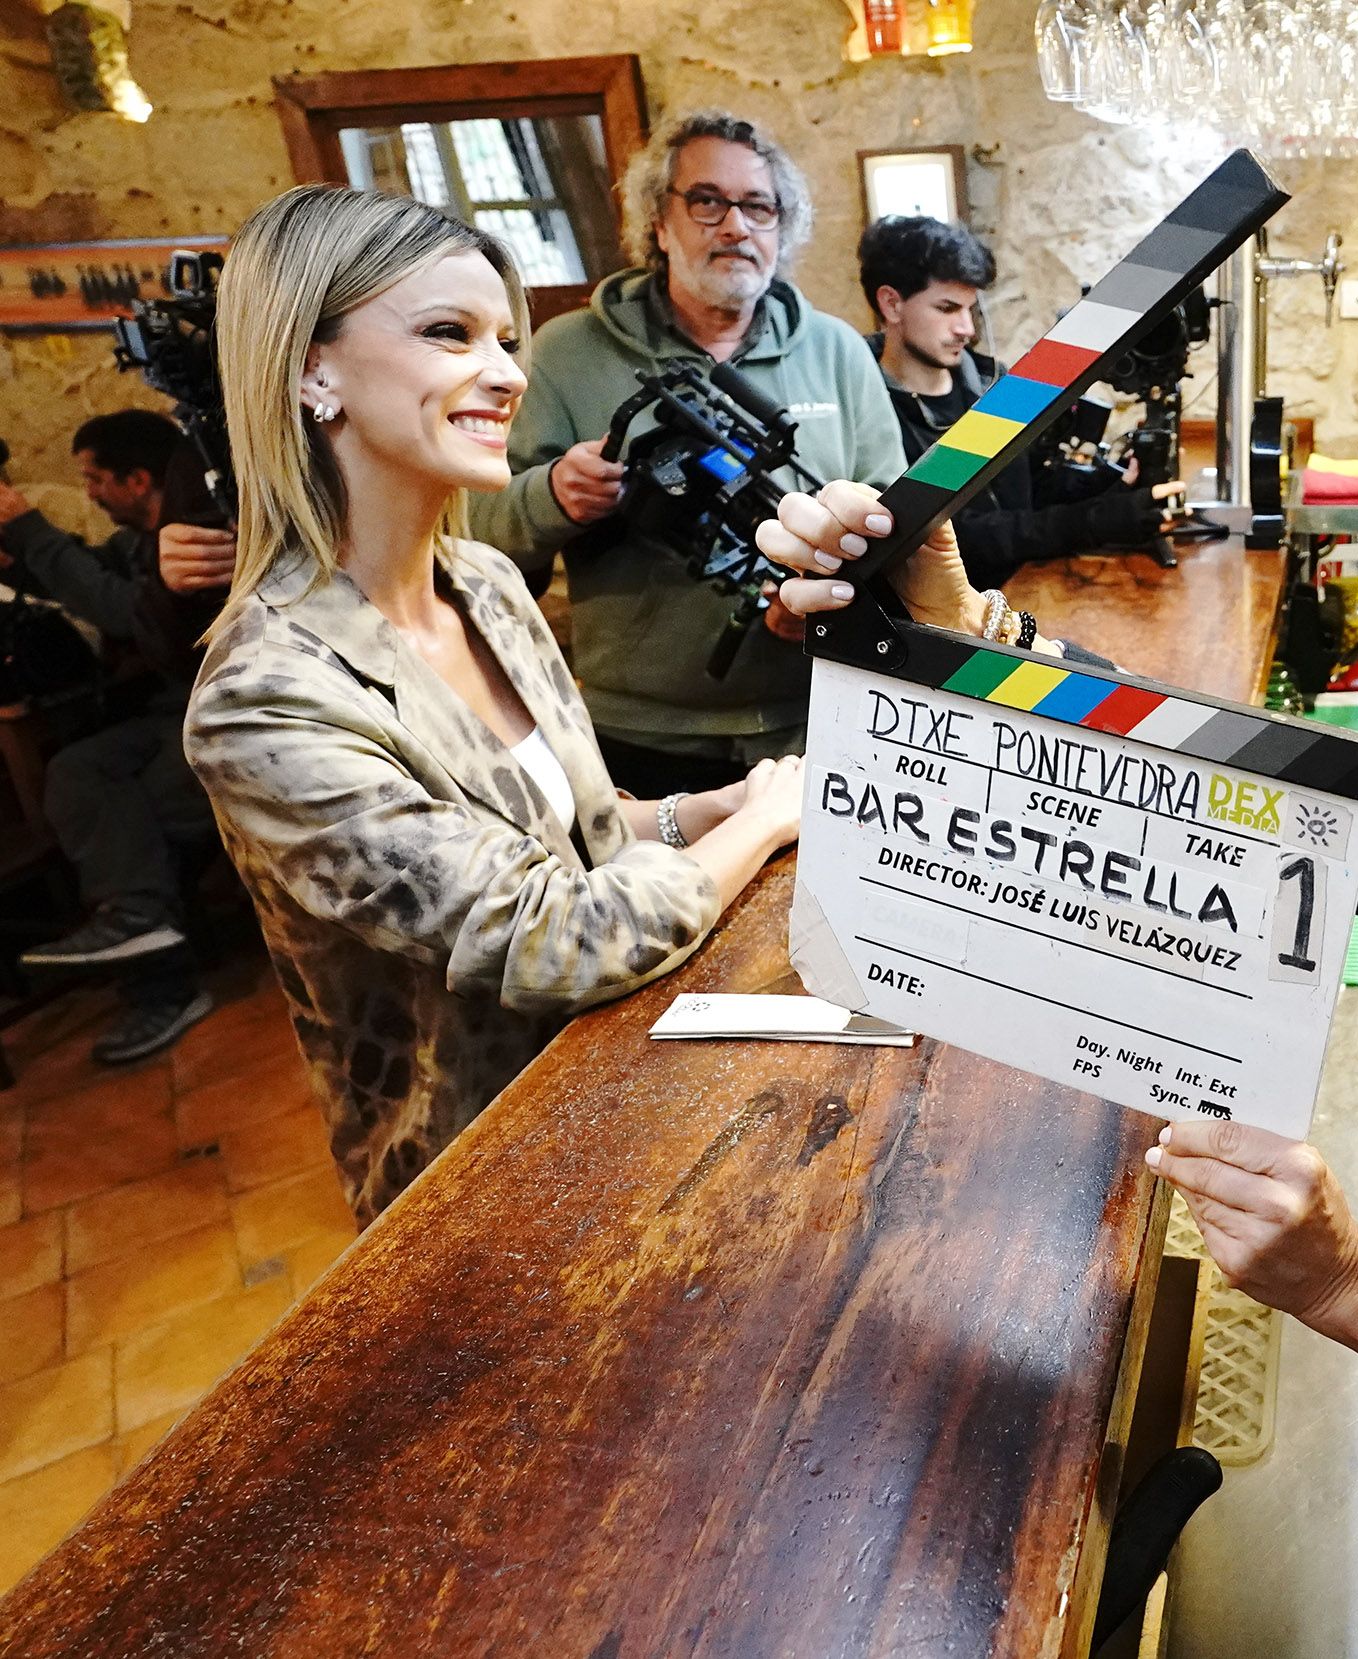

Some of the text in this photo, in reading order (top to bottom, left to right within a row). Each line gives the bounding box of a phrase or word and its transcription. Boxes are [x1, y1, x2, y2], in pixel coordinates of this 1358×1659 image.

[895, 754, 948, 786] ROLL
[992, 721, 1200, 819] PONTEVEDRA
[1026, 790, 1103, 828] SCENE
[1207, 773, 1285, 828] DEX
[1207, 803, 1280, 835] MEDIA
[821, 772, 1238, 933] BAR ESTRELLA
[1185, 833, 1247, 868] TAKE
[877, 847, 1242, 971] DIRECTOR: JOSÉ LUIS VELÁZQUEZ
[1278, 857, 1316, 972] 1
[866, 962, 926, 998] DATE:
[1072, 1058, 1103, 1078] FPS
[1076, 1035, 1238, 1099] Day. Night Int. Ext
[1149, 1083, 1191, 1109] Sync.
